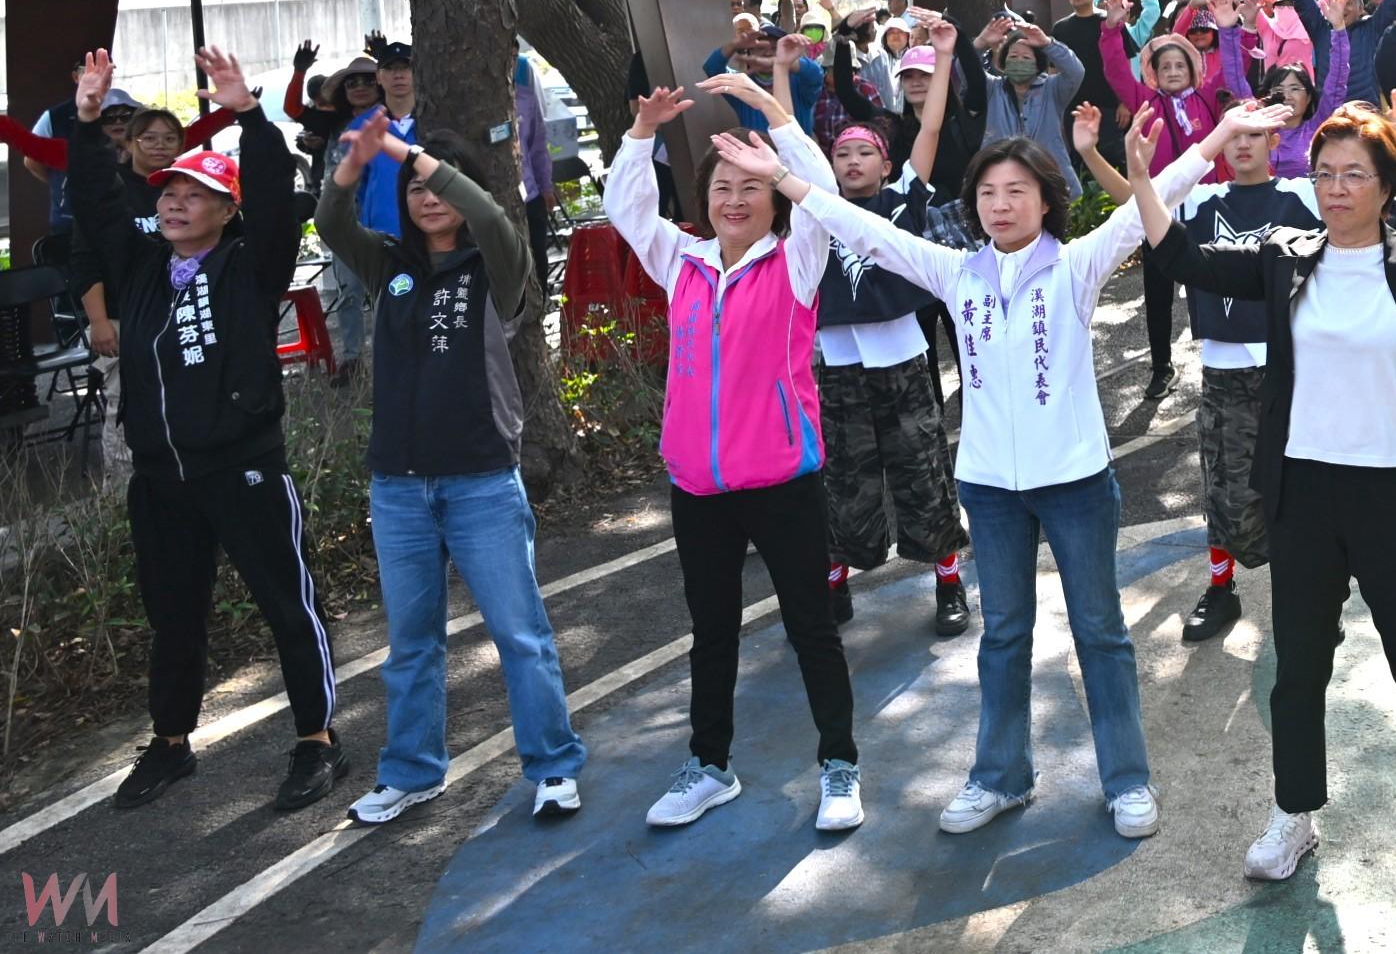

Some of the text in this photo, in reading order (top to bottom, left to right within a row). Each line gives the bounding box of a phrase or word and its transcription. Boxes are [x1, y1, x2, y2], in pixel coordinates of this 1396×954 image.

[429, 288, 451, 353] 許文萍
[961, 299, 982, 389] 黃佳惠
[979, 294, 996, 342] 副主席
[1031, 287, 1050, 406] 溪湖鎮民代表會
